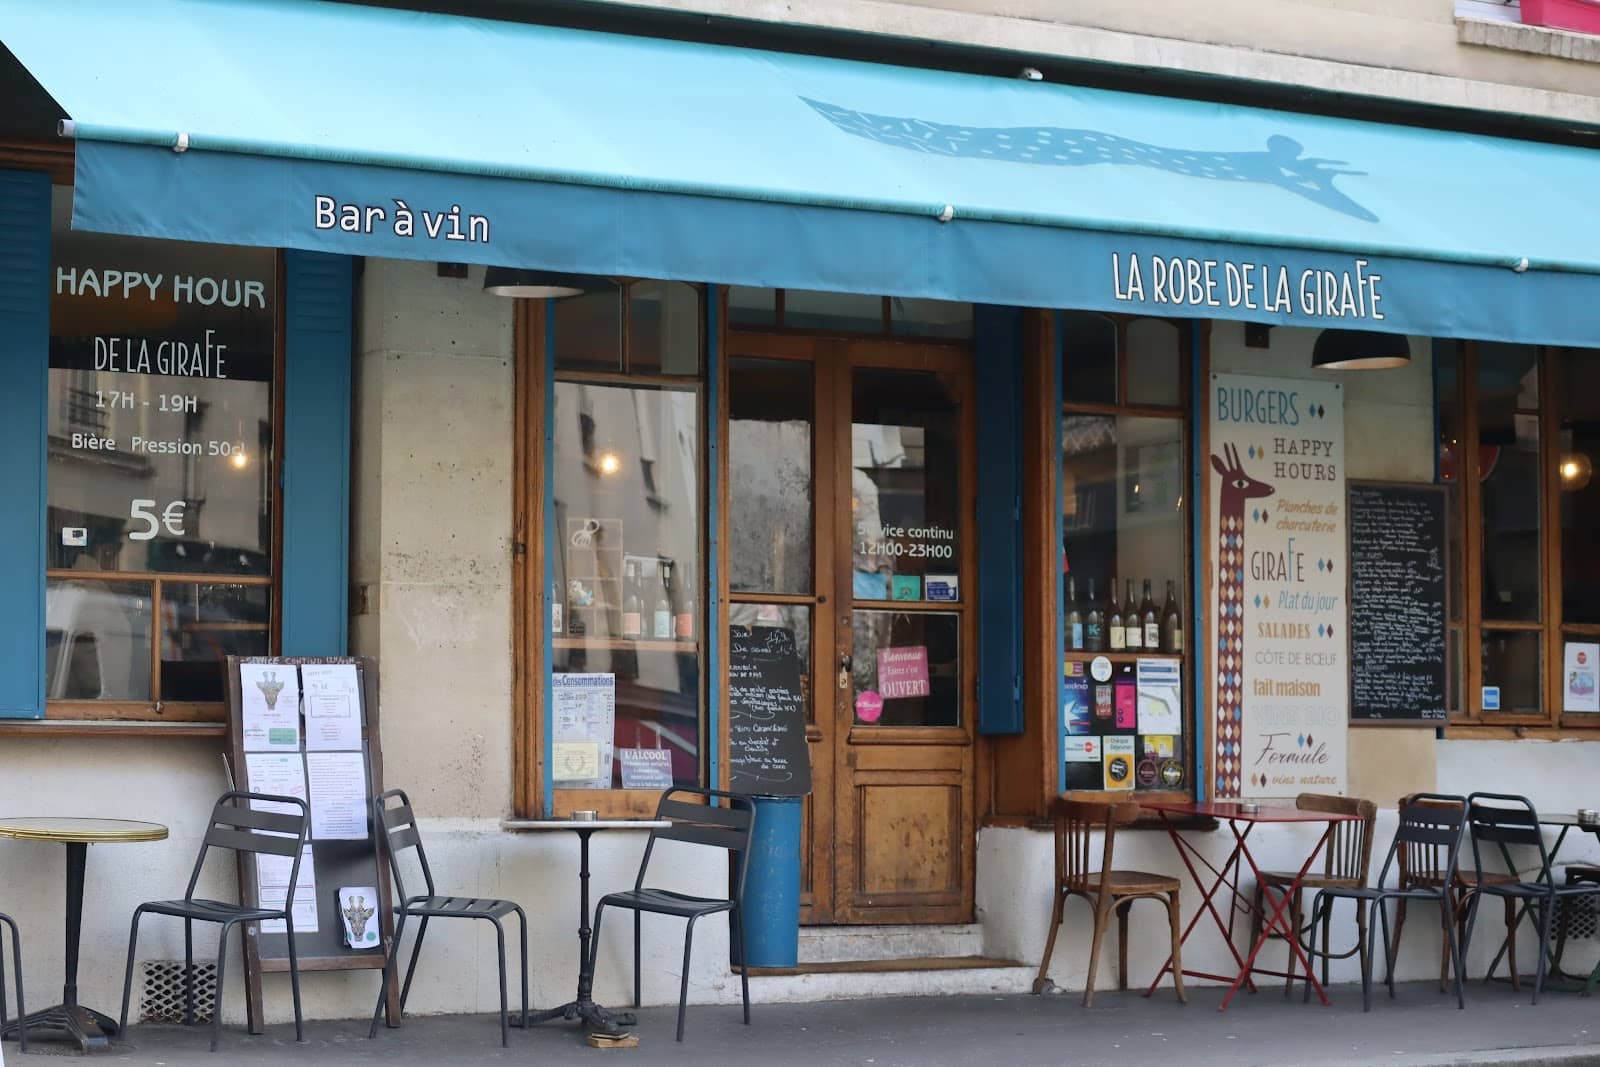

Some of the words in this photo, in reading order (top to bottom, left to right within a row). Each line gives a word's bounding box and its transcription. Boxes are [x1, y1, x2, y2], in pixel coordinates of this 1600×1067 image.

[314, 195, 385, 234] Bar
[393, 199, 414, 237] à
[422, 205, 490, 243] vin
[56, 266, 163, 300] HAPPY
[173, 276, 266, 308] HOUR
[1112, 253, 1145, 301] LA
[1153, 256, 1220, 306] ROBE
[1225, 261, 1257, 309] DE
[1263, 266, 1292, 313] LA
[1300, 259, 1384, 320] GIRAFE
[94, 336, 120, 372] DE
[126, 339, 150, 374] LA
[157, 329, 227, 378] GIRAFE
[95, 391, 134, 409] 17H
[158, 395, 197, 413] 19H
[1217, 387, 1300, 426] BURGERS
[71, 433, 116, 450] Bière
[131, 437, 202, 456] Pression
[1273, 438, 1334, 457] HAPPY
[1274, 462, 1336, 481] HOURS
[1277, 499, 1323, 515] Planches
[1325, 501, 1338, 515] de
[129, 498, 186, 540] 5€
[1276, 516, 1337, 533] charcuterie
[858, 521, 904, 537] Svice
[907, 526, 954, 540] continu
[860, 541, 953, 558] 12H00-23H00
[1251, 538, 1305, 582] GIRAFE
[1278, 590, 1301, 609] Plat
[1301, 592, 1315, 611] du
[1314, 595, 1339, 615] jour
[1258, 622, 1311, 639] SALADES
[883, 651, 922, 663] Bienvenue
[1255, 648, 1284, 665] CÔTE
[1288, 652, 1302, 666] DE
[562, 675, 614, 687] Consommations
[883, 680, 927, 696] OUVERT
[1253, 677, 1273, 696] fait
[1276, 679, 1321, 697] maison
[1254, 732, 1331, 765] Formule
[1272, 776, 1296, 785] vins
[1300, 774, 1337, 785] nature
